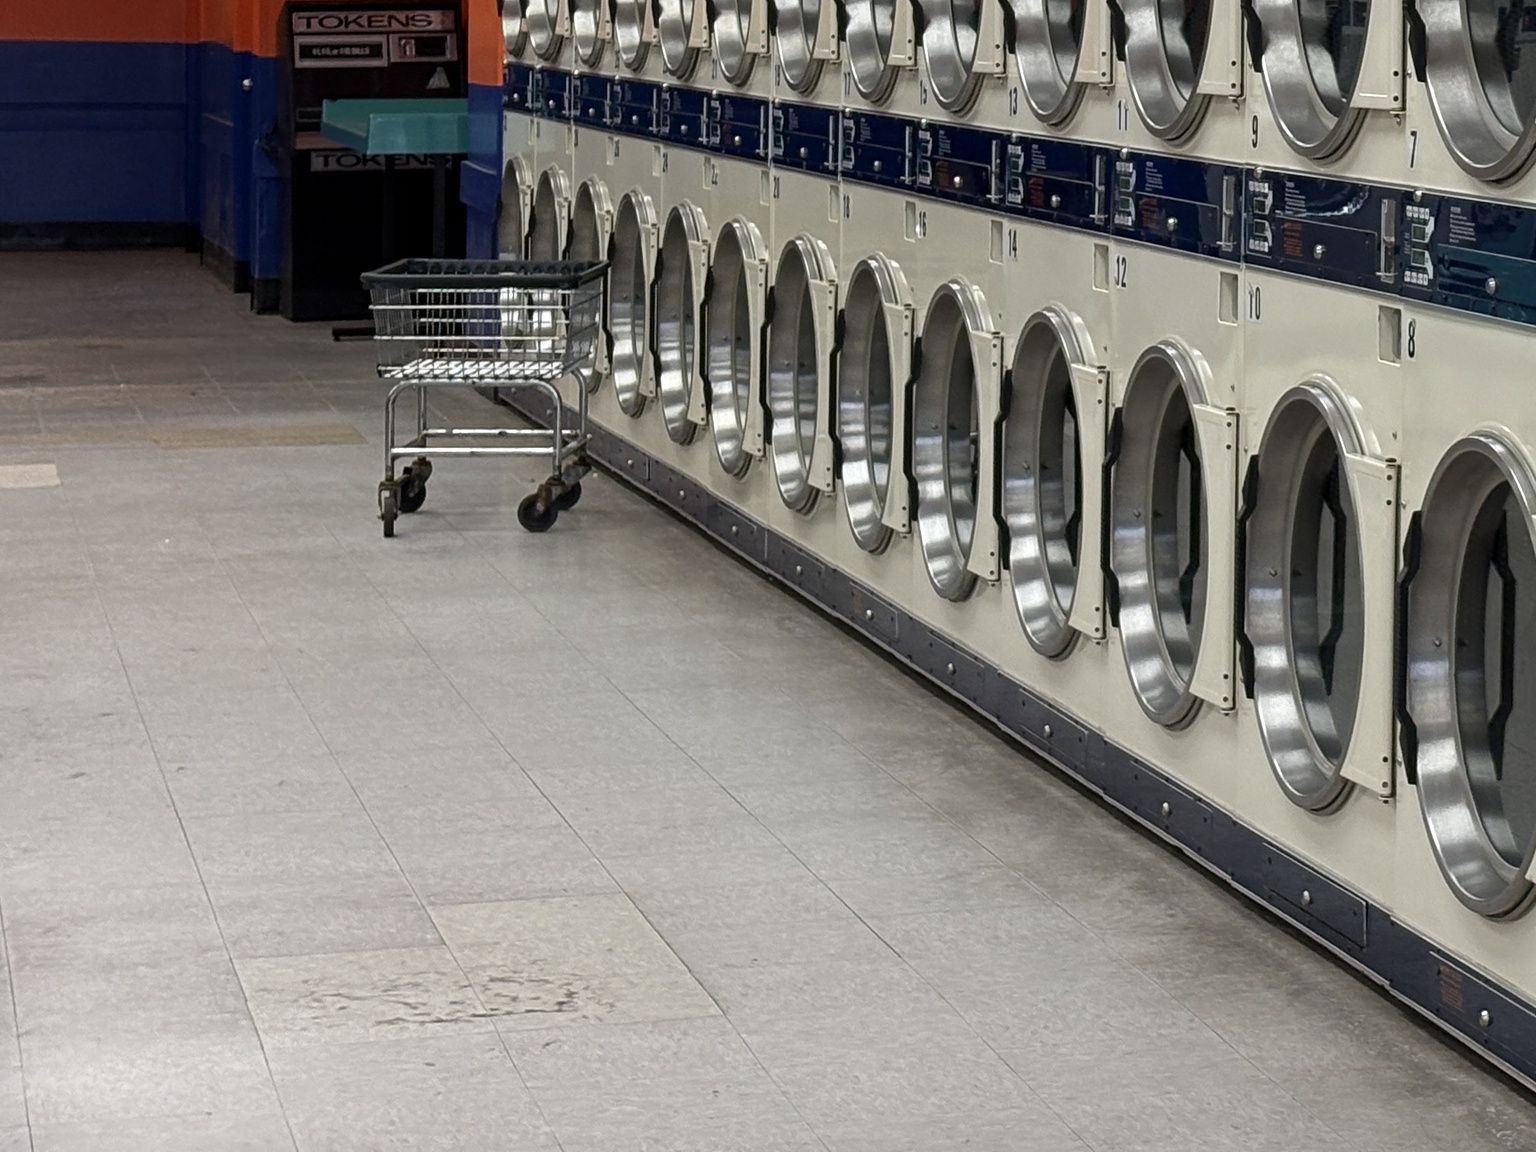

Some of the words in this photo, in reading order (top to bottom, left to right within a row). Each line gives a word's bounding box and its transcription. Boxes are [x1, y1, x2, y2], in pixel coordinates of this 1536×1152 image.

[298, 14, 433, 29] TOKENS
[1009, 87, 1018, 116] 13
[1118, 100, 1129, 131] 11
[1252, 115, 1258, 149] 9
[1410, 130, 1417, 168] 7
[1008, 229, 1017, 258] 14
[1114, 256, 1127, 288] 12
[1248, 282, 1261, 320] 10
[1408, 319, 1416, 359] 8
